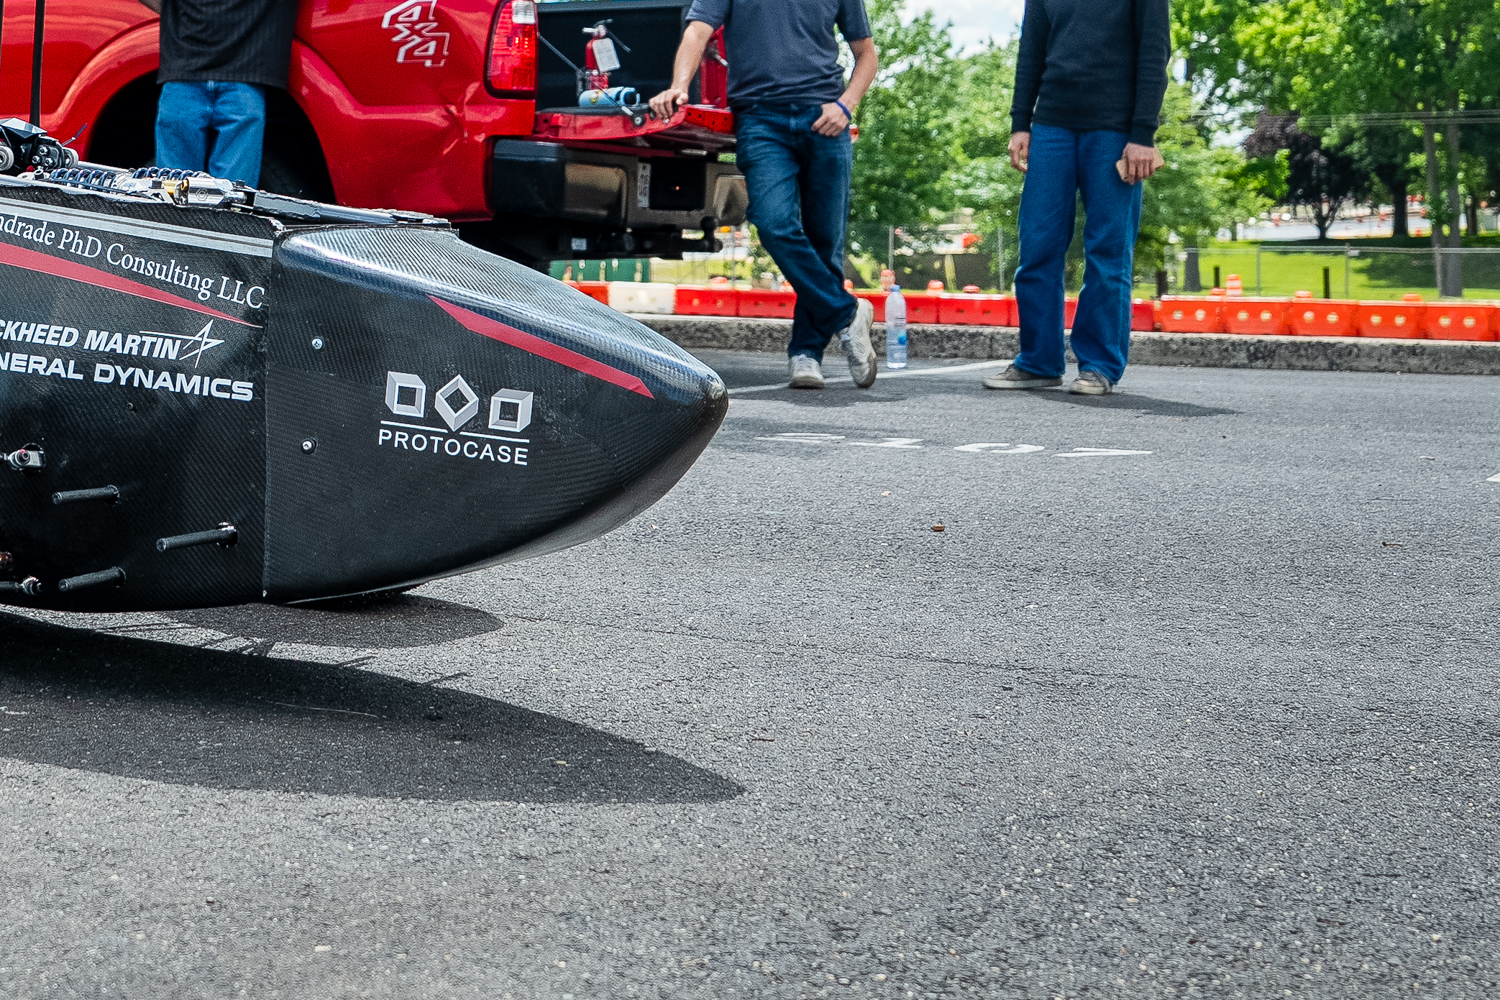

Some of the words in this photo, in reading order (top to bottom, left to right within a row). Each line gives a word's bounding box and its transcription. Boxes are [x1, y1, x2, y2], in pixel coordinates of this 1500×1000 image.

[58, 228, 101, 258] PhD
[106, 243, 214, 300] Consulting
[217, 276, 265, 309] LLC
[84, 329, 181, 361] MARTIN
[94, 362, 254, 401] DYNAMICS
[378, 428, 529, 466] PROTOCASE
